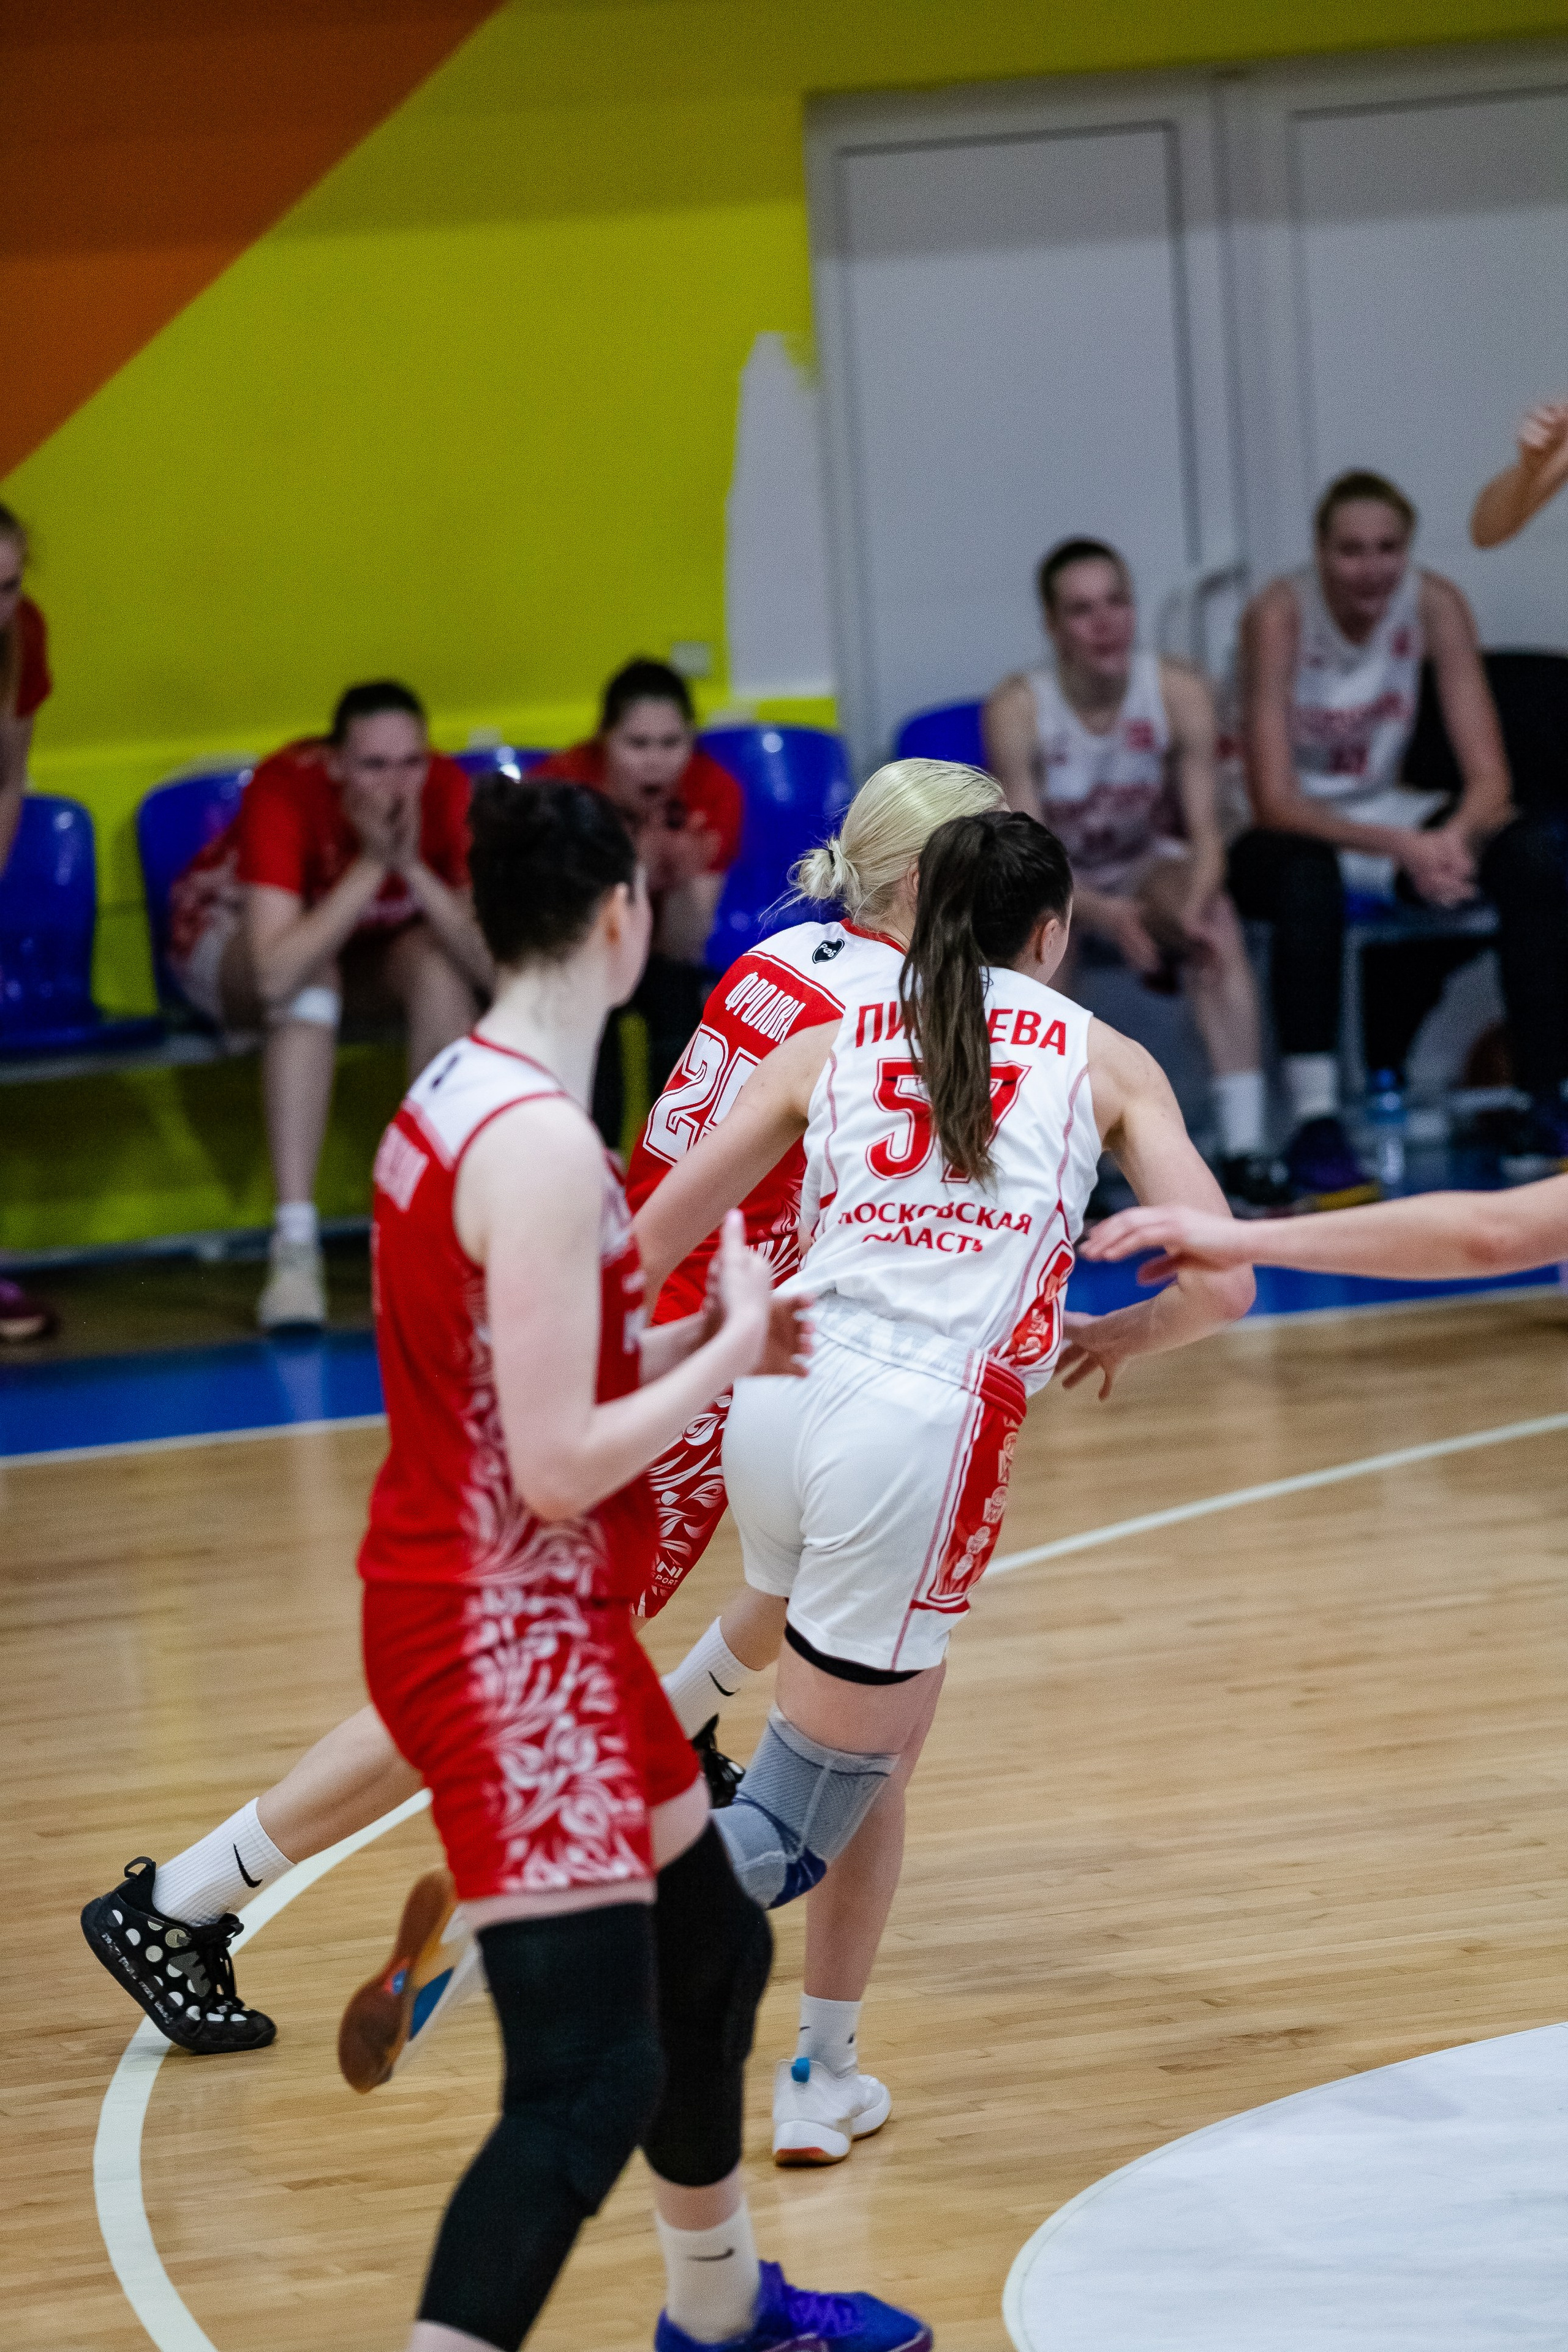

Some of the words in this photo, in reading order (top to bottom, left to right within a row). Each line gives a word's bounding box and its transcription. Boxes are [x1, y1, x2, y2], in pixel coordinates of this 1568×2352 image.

[725, 971, 807, 1044] ФРОЛОВА
[856, 1000, 1067, 1057] ПИЕВА
[865, 1057, 1032, 1183] 57
[861, 1226, 983, 1254] ЛАСТЬ
